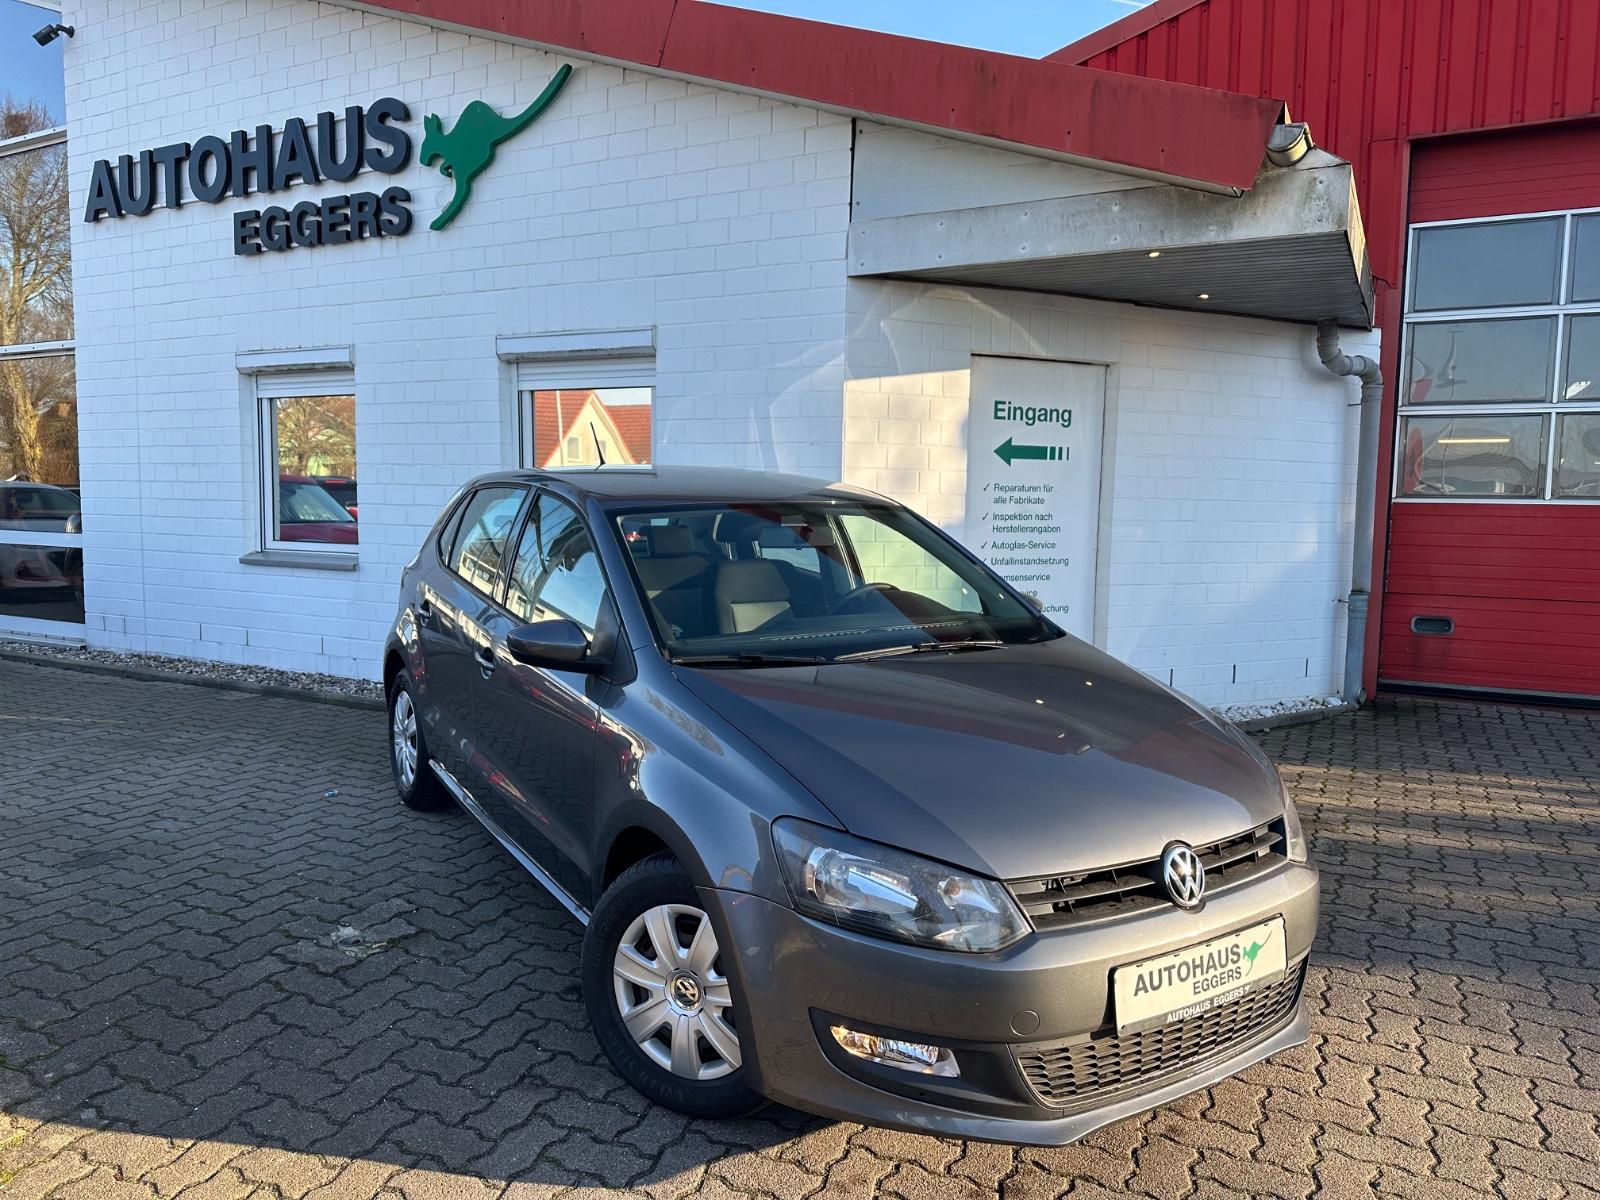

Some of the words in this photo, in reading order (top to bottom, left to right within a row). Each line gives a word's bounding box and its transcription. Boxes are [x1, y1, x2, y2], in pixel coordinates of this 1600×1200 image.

[84, 97, 412, 223] AUTOHAUS
[233, 186, 413, 256] EGGERS
[993, 400, 1072, 428] Eingang
[993, 483, 1041, 494] Reparaturen
[1043, 483, 1054, 493] für
[993, 495, 1007, 505] alle
[1008, 495, 1045, 505] Fabrikate
[992, 512, 1032, 523] Inspektion
[1034, 512, 1053, 521] nach
[992, 524, 1061, 535] Herstellerangaben
[991, 541, 1056, 551] Autoglas-Service
[990, 556, 1070, 567] Unfallinstandsetzung
[1133, 943, 1241, 997] AUTOHAUS
[1192, 965, 1242, 996] EGGERS
[1166, 1000, 1211, 1024] AUTOHAUS
[1213, 987, 1245, 1007] EGGERS
